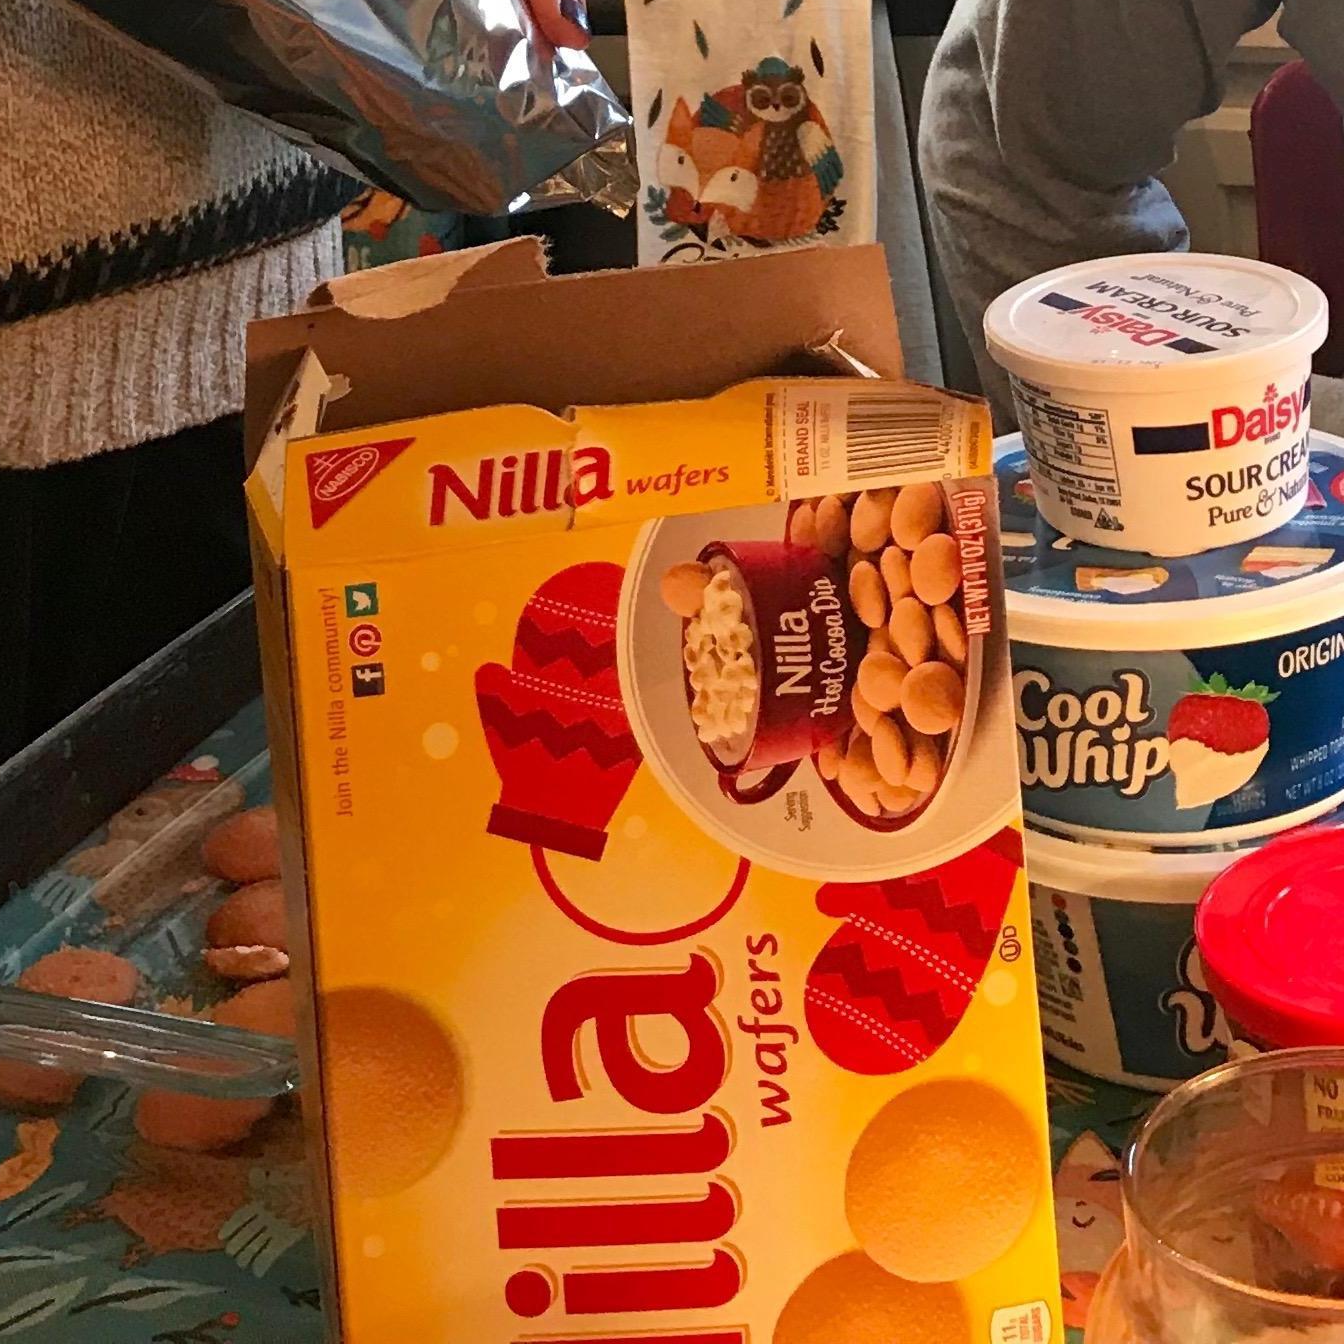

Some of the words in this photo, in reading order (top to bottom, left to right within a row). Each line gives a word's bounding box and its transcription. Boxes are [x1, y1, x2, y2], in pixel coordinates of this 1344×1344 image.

[1085, 280, 1178, 314] CREAM
[1130, 273, 1198, 298] Natural
[1068, 304, 1181, 347] Daisy
[1171, 308, 1252, 338] SOUR
[795, 400, 810, 424] SEAL
[1211, 384, 1305, 449] Daisy
[796, 425, 810, 477] BRAND
[1185, 463, 1263, 501] SOUR
[1266, 430, 1309, 482] CREA
[319, 451, 373, 497] NABISCO
[428, 442, 617, 527] Nilla
[625, 462, 731, 496] wafers
[952, 490, 988, 534] (311g)
[1208, 505, 1253, 527] Pure
[960, 535, 985, 559] OZ
[961, 561, 987, 576] 11
[808, 576, 842, 613] Dip
[962, 579, 989, 603] WT
[318, 587, 342, 693] community!
[966, 605, 992, 636] NET
[773, 608, 813, 697] Nilla
[819, 611, 848, 673] Cocoa
[809, 673, 845, 718] Hot
[1013, 668, 1150, 730] Cool
[327, 699, 347, 741] Nilla
[332, 746, 349, 776] the
[1018, 722, 1172, 798] Whip
[1289, 744, 1328, 772] WHIPPED
[336, 780, 354, 817] Join
[784, 791, 797, 822] Serving
[798, 790, 813, 832] Suggestion
[1285, 783, 1302, 800] NET
[737, 932, 801, 1128] wafers
[1313, 1076, 1339, 1100] NO
[490, 952, 748, 1344] illa
